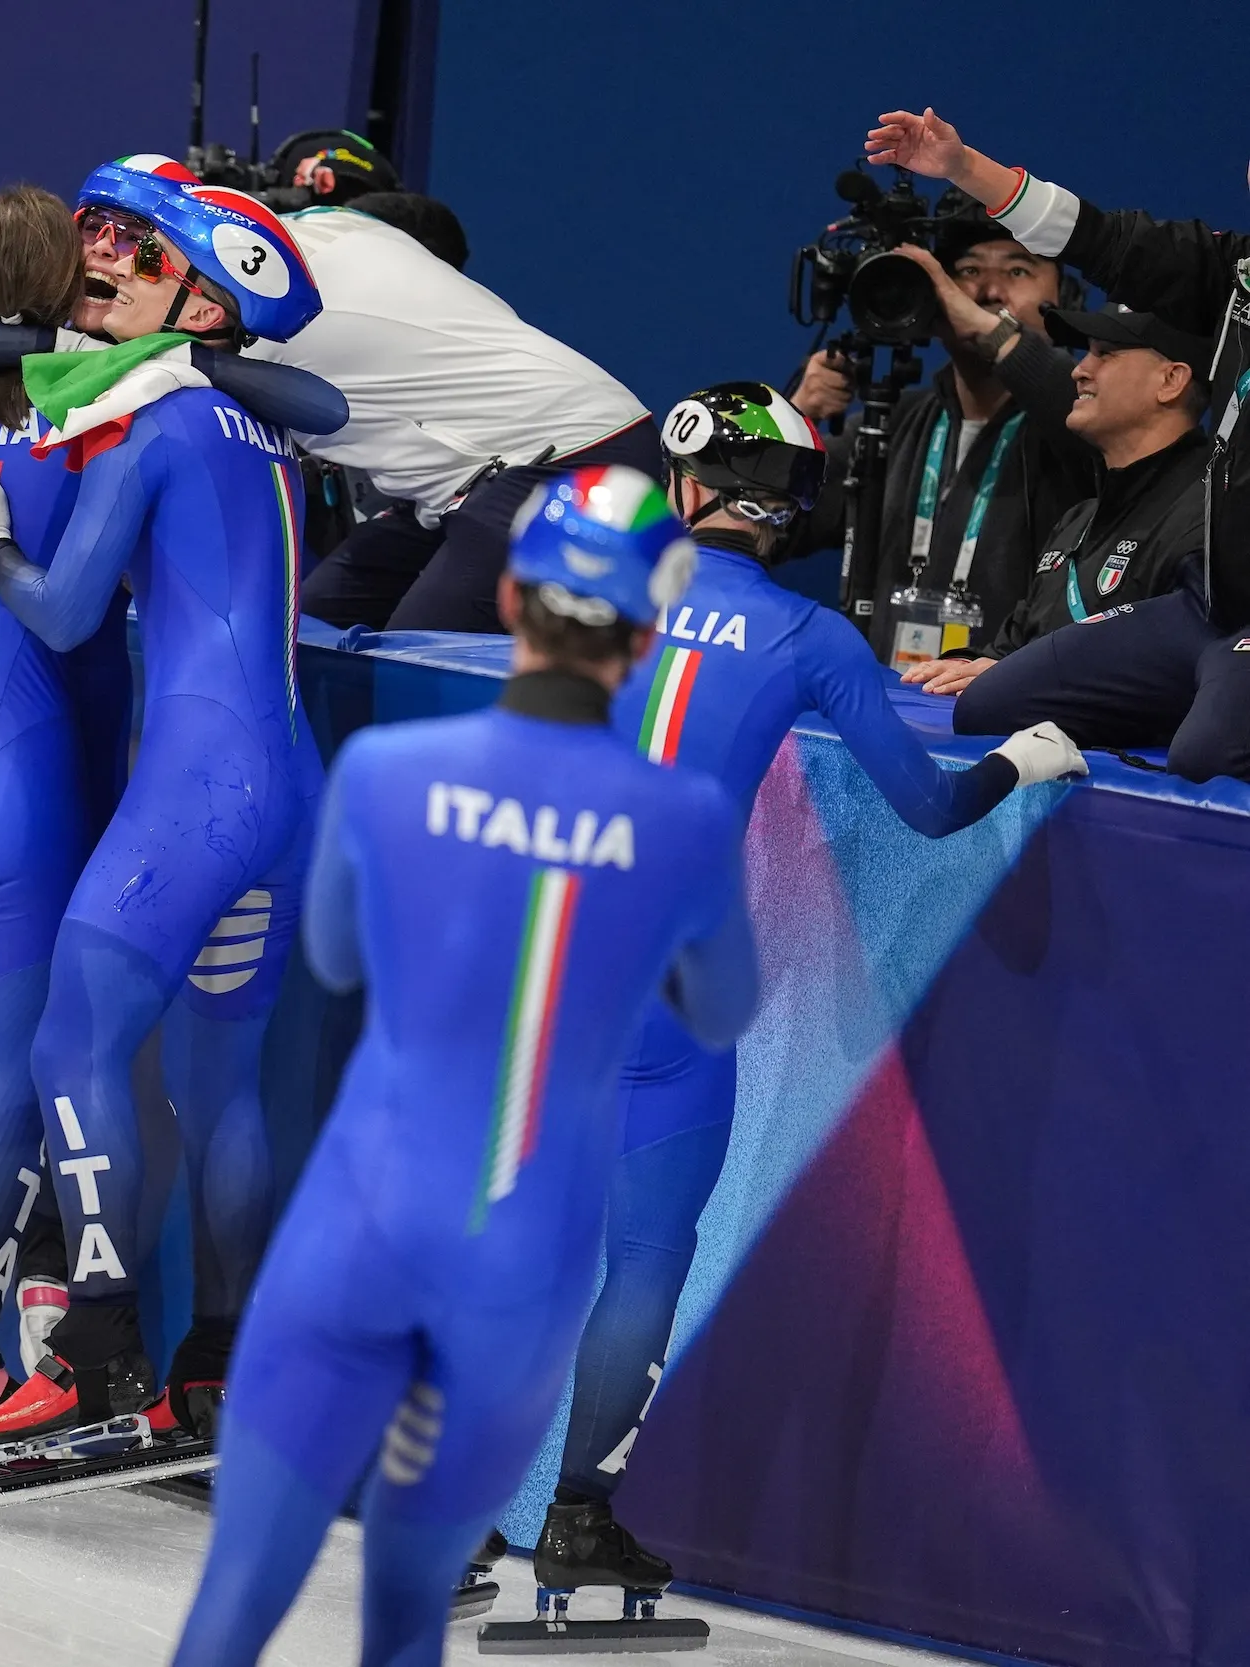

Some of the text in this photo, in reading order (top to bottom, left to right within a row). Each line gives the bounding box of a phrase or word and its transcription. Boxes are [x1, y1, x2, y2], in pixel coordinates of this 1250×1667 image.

[204, 204, 258, 228] RUDY
[241, 245, 267, 276] 3
[213, 406, 296, 461] ITALIA
[670, 398, 700, 444] 10
[425, 781, 635, 872] ITALIA
[54, 1096, 127, 1283] ITA
